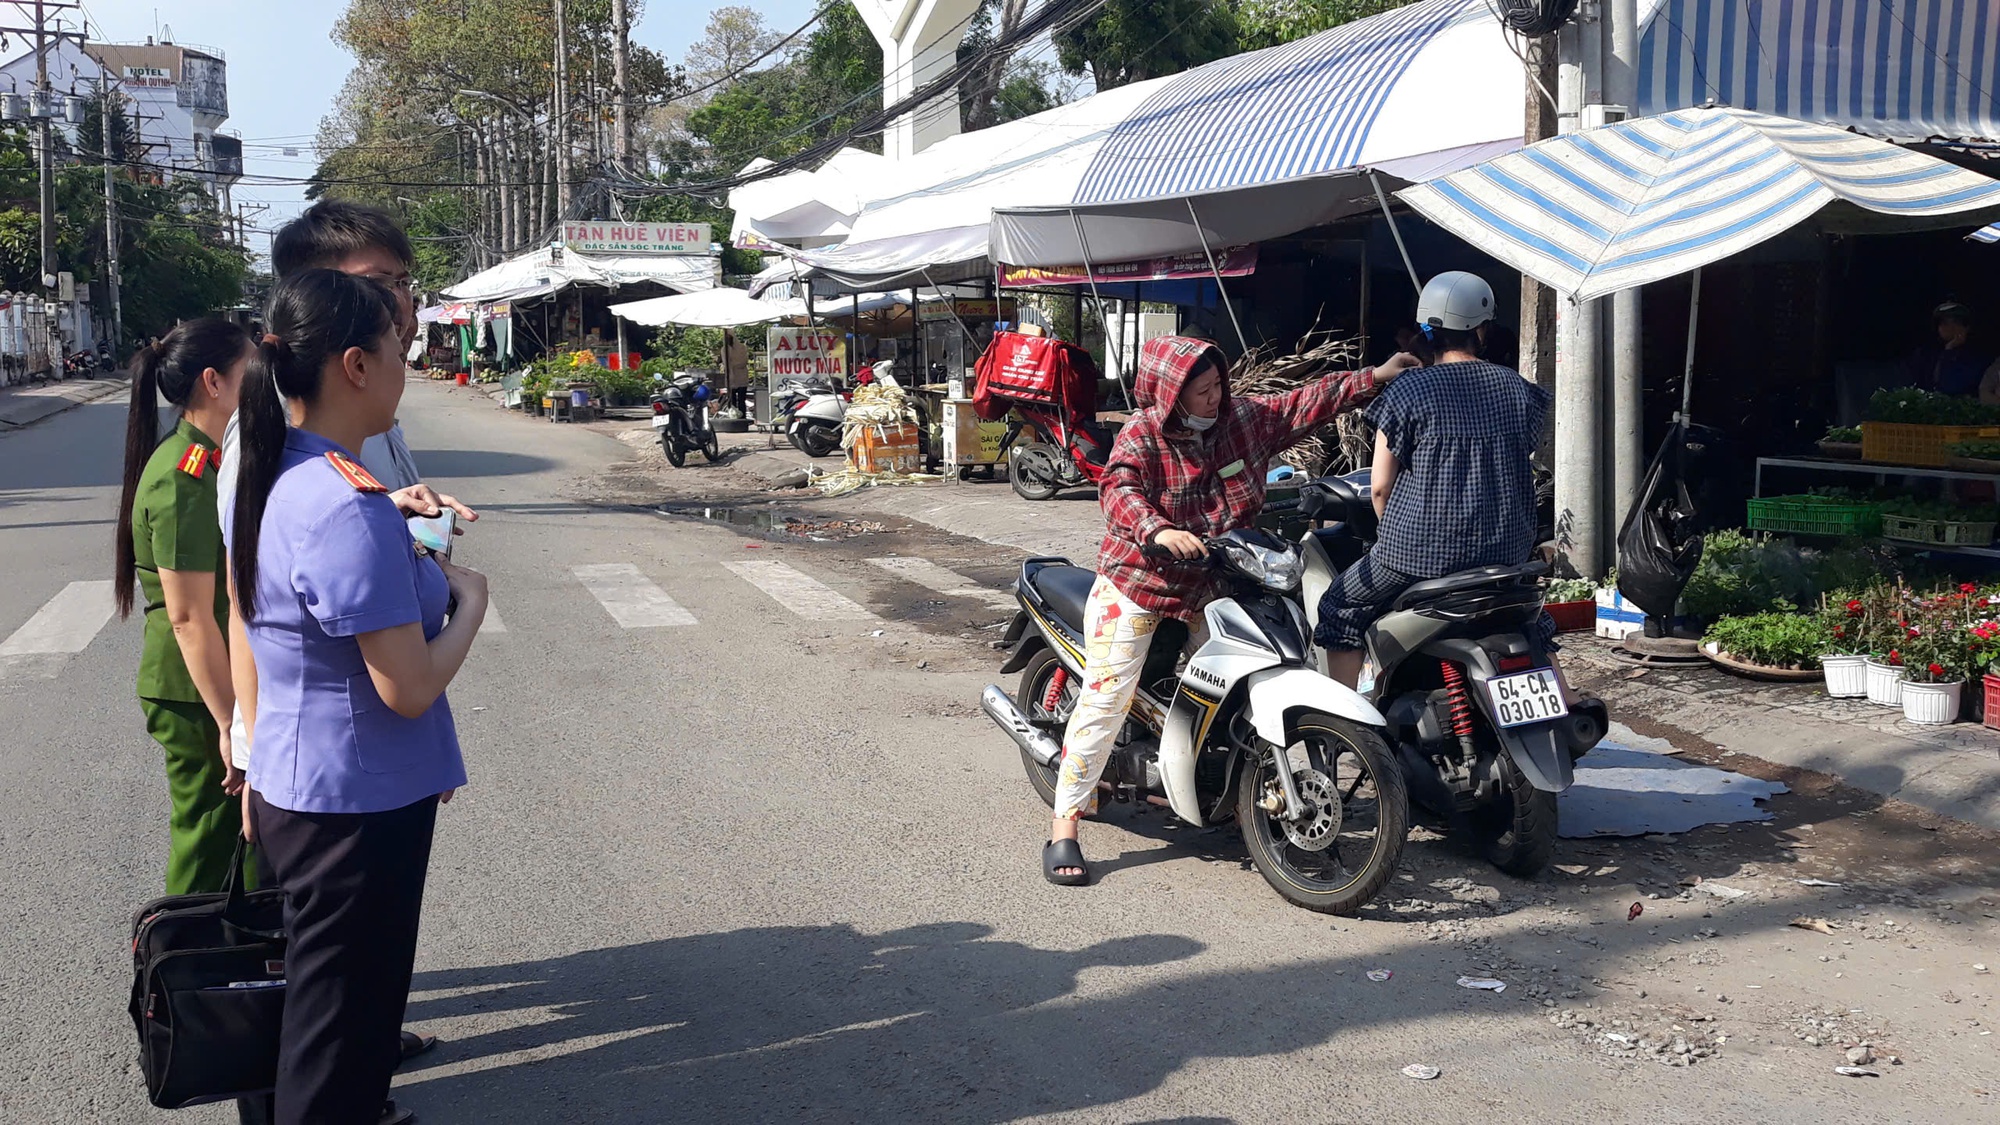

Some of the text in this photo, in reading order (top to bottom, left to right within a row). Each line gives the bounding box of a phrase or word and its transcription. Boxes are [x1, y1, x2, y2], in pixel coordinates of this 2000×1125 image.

[130, 68, 163, 76] HOTEL
[565, 222, 699, 242] TÂN HUÊ VIÊN
[776, 335, 792, 351] A
[774, 353, 812, 374] NƯỚC
[1190, 664, 1226, 690] YAMAHA
[1497, 673, 1550, 700] 64-CA
[1499, 694, 1561, 723] 030.18
